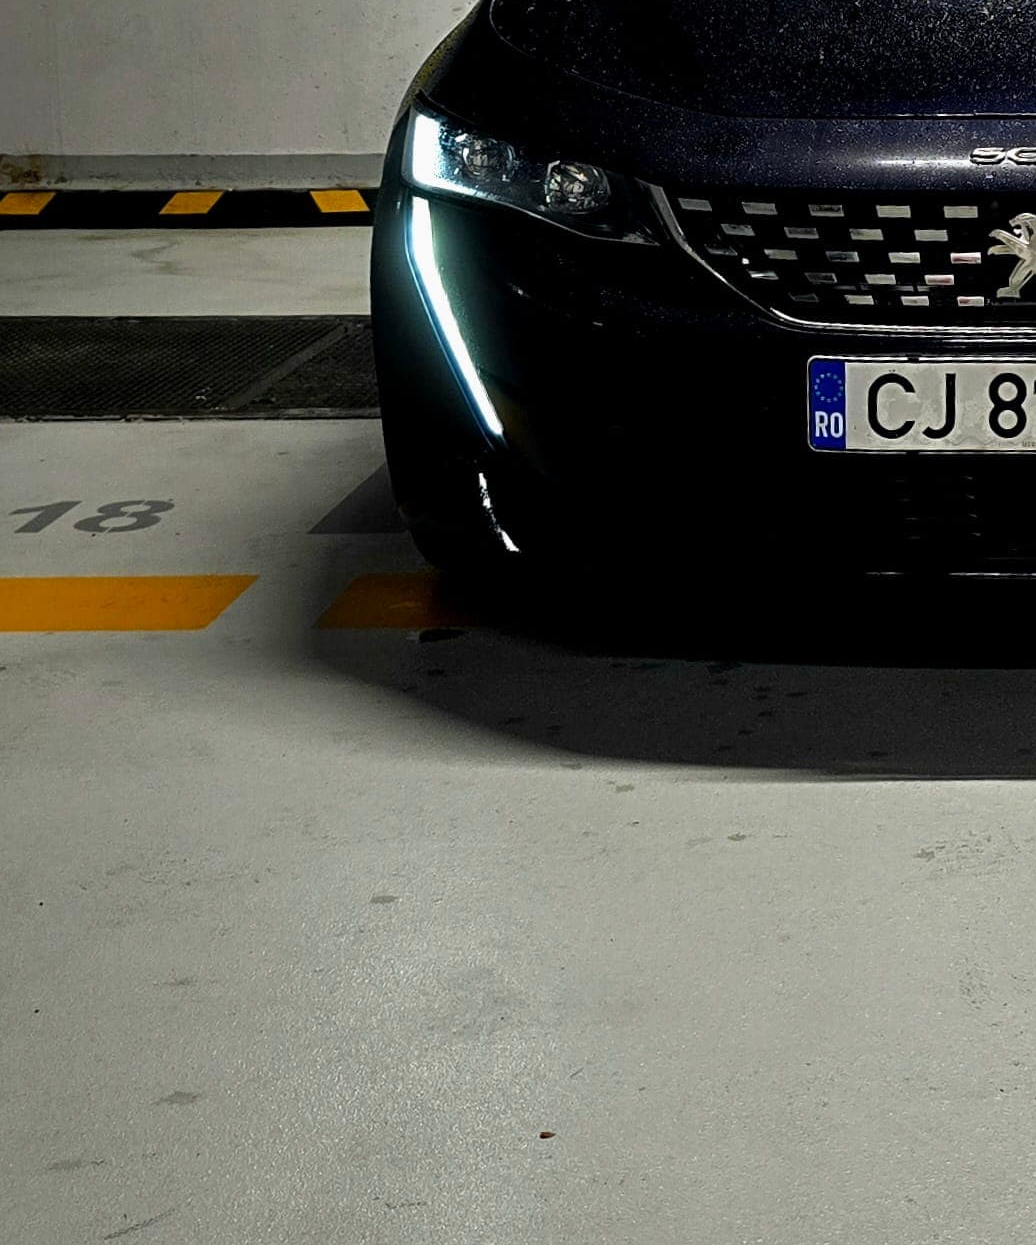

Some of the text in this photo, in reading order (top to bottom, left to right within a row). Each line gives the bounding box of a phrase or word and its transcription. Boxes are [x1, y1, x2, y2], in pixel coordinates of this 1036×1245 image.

[867, 372, 956, 439] CJ
[815, 411, 843, 438] RO
[9, 500, 175, 533] 18
